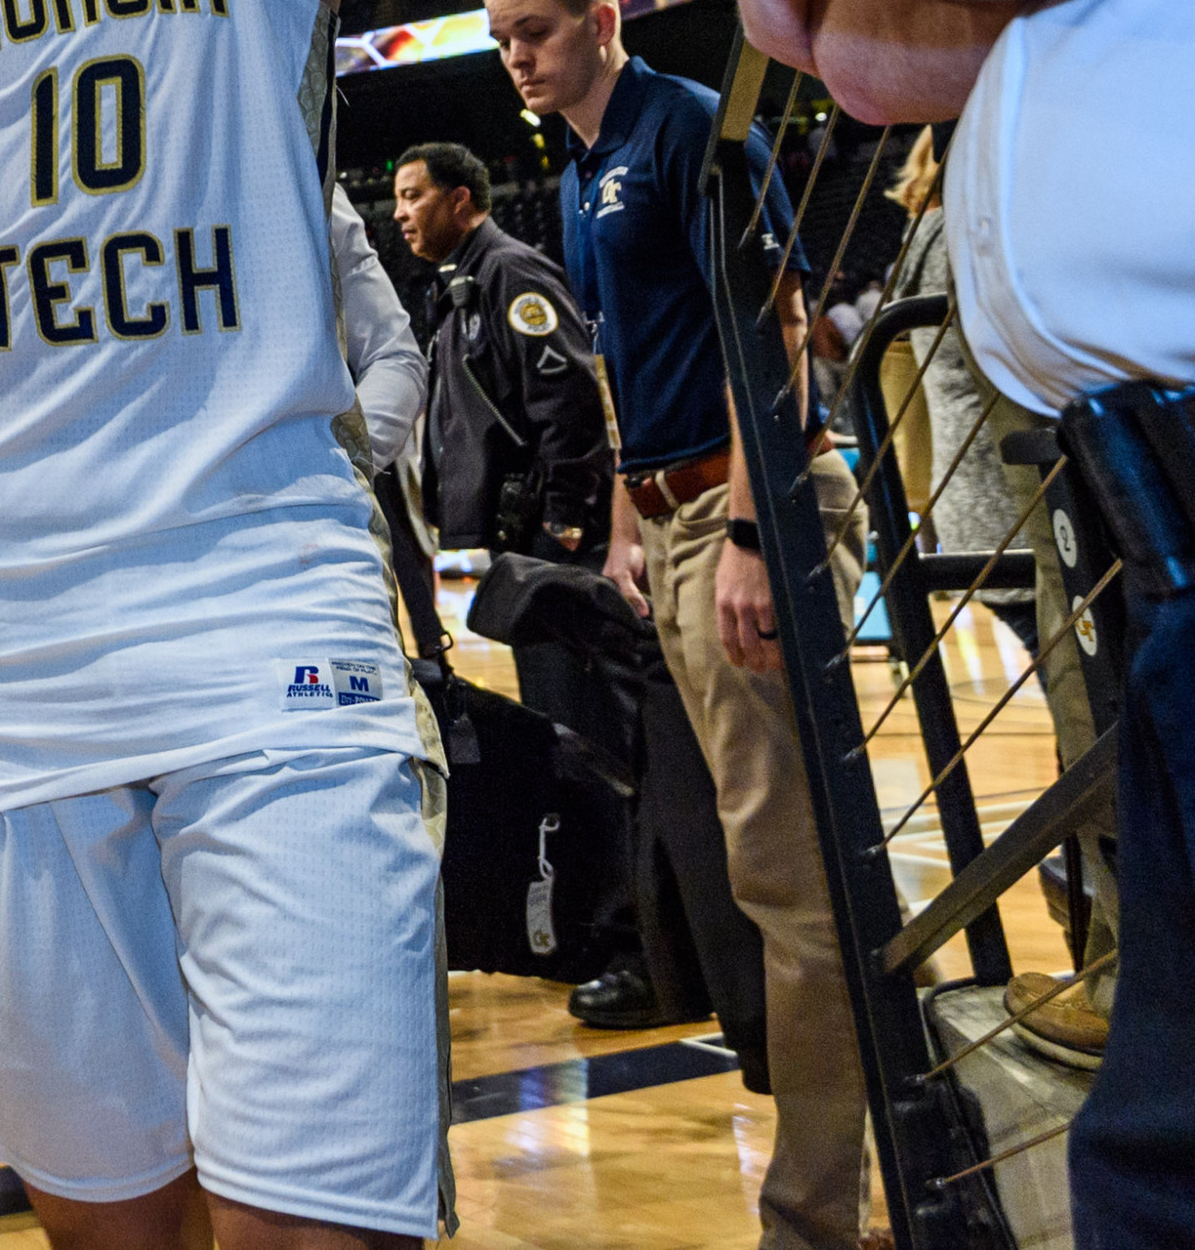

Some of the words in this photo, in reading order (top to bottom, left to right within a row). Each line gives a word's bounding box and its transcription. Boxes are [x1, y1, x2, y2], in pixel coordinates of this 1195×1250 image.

[30, 54, 146, 208] 10
[287, 684, 331, 693] RUSSELL
[349, 675, 369, 692] M
[286, 690, 334, 698] ATHLETIC
